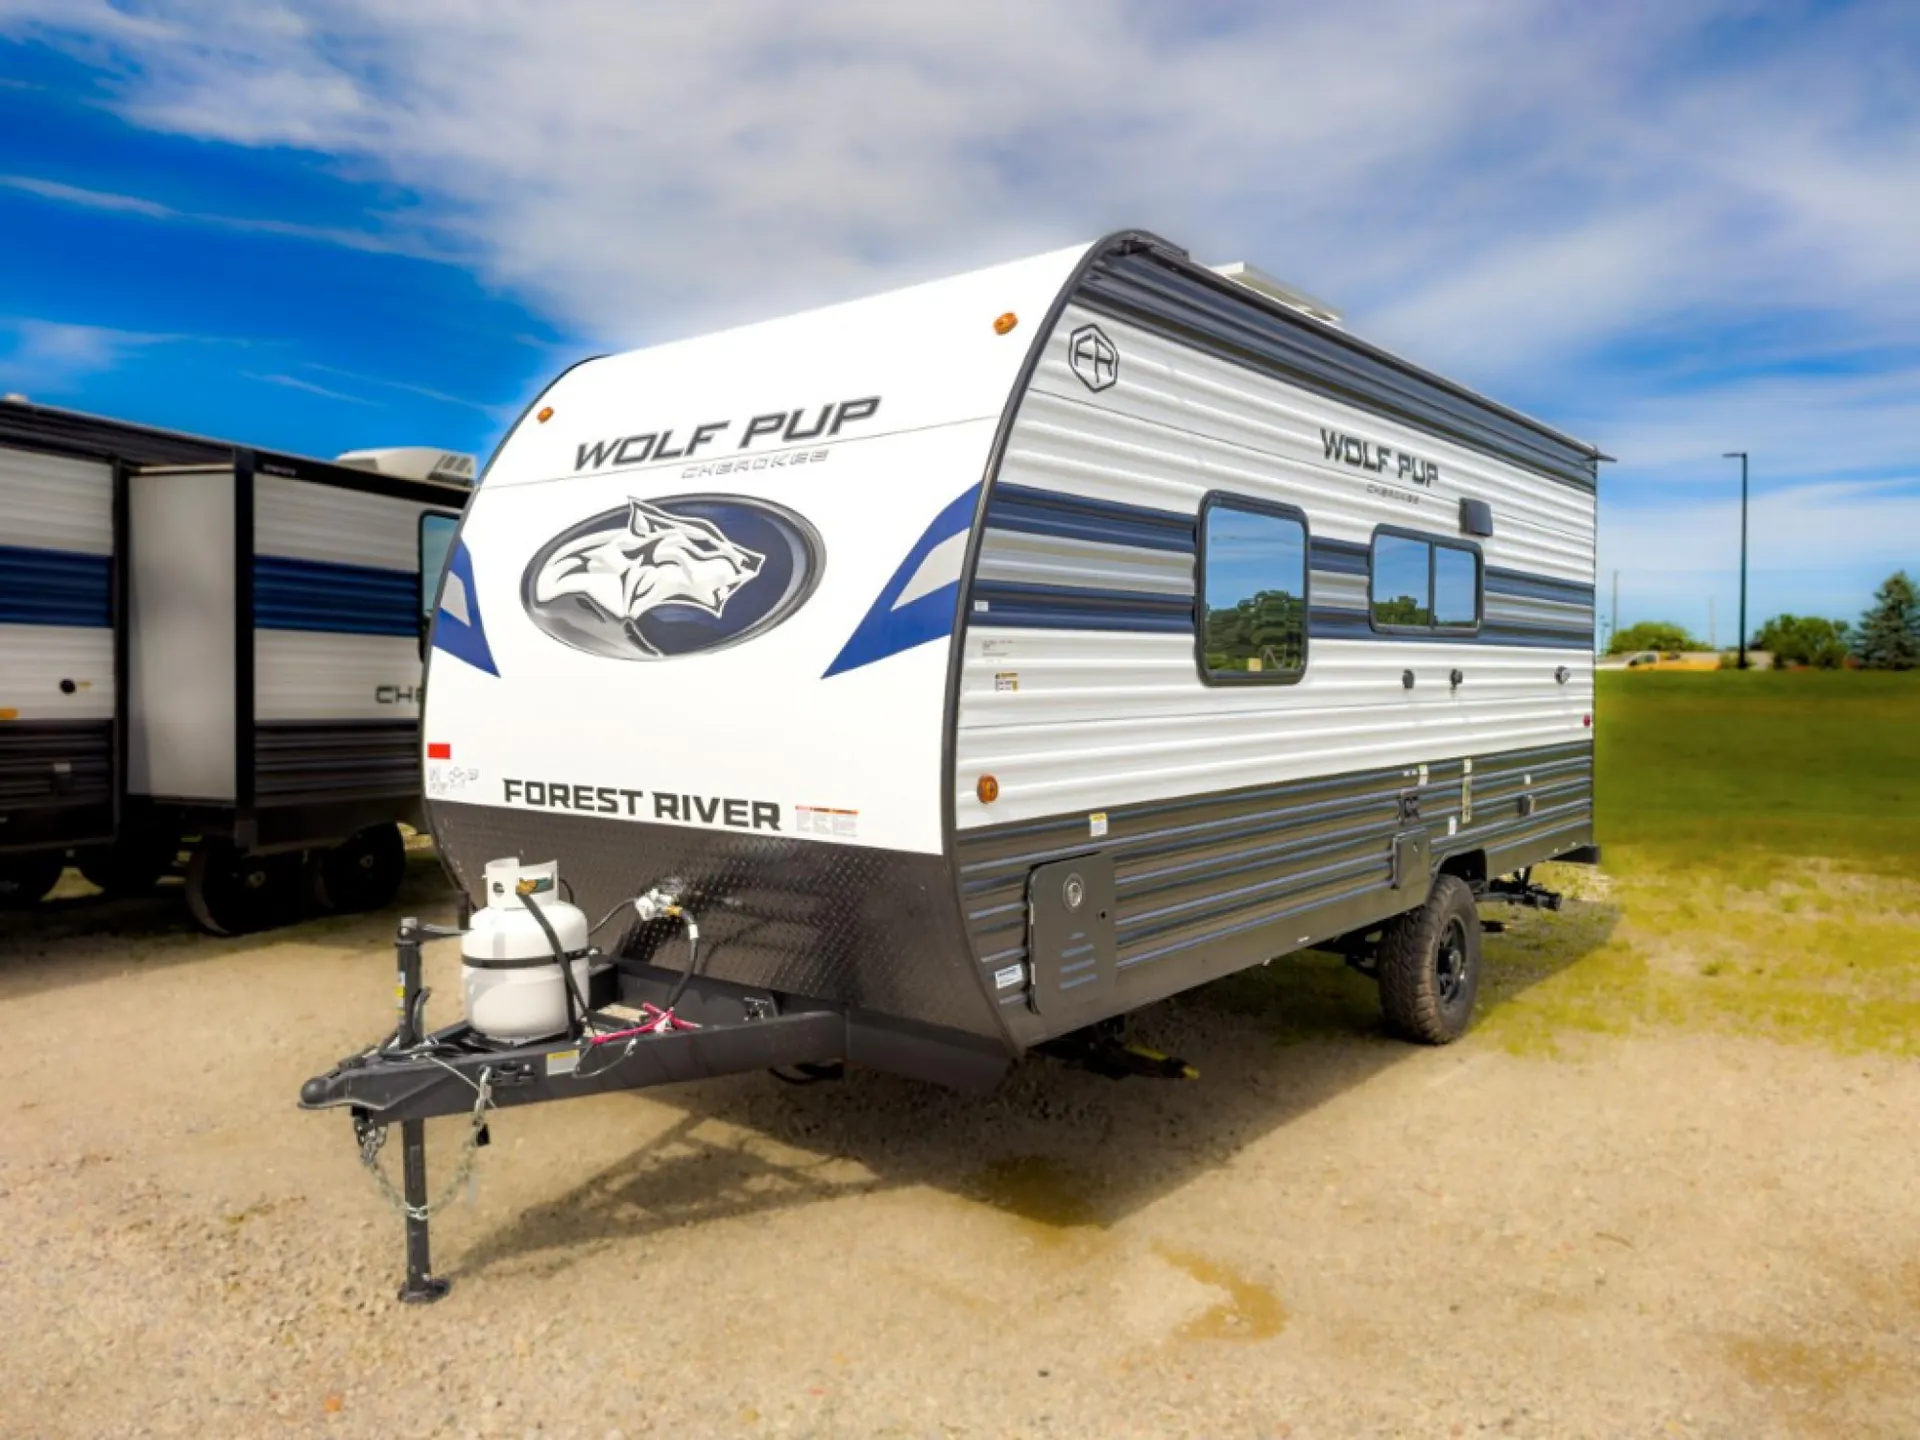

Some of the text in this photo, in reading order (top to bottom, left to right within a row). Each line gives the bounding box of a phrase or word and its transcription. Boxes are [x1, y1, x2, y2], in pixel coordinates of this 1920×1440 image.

[573, 396, 882, 471] WOLF PUP
[1320, 428, 1439, 488] WOLF PUP
[681, 449, 829, 479] CHEROKEE
[502, 778, 642, 815] FOREST
[653, 792, 781, 831] RIVER
